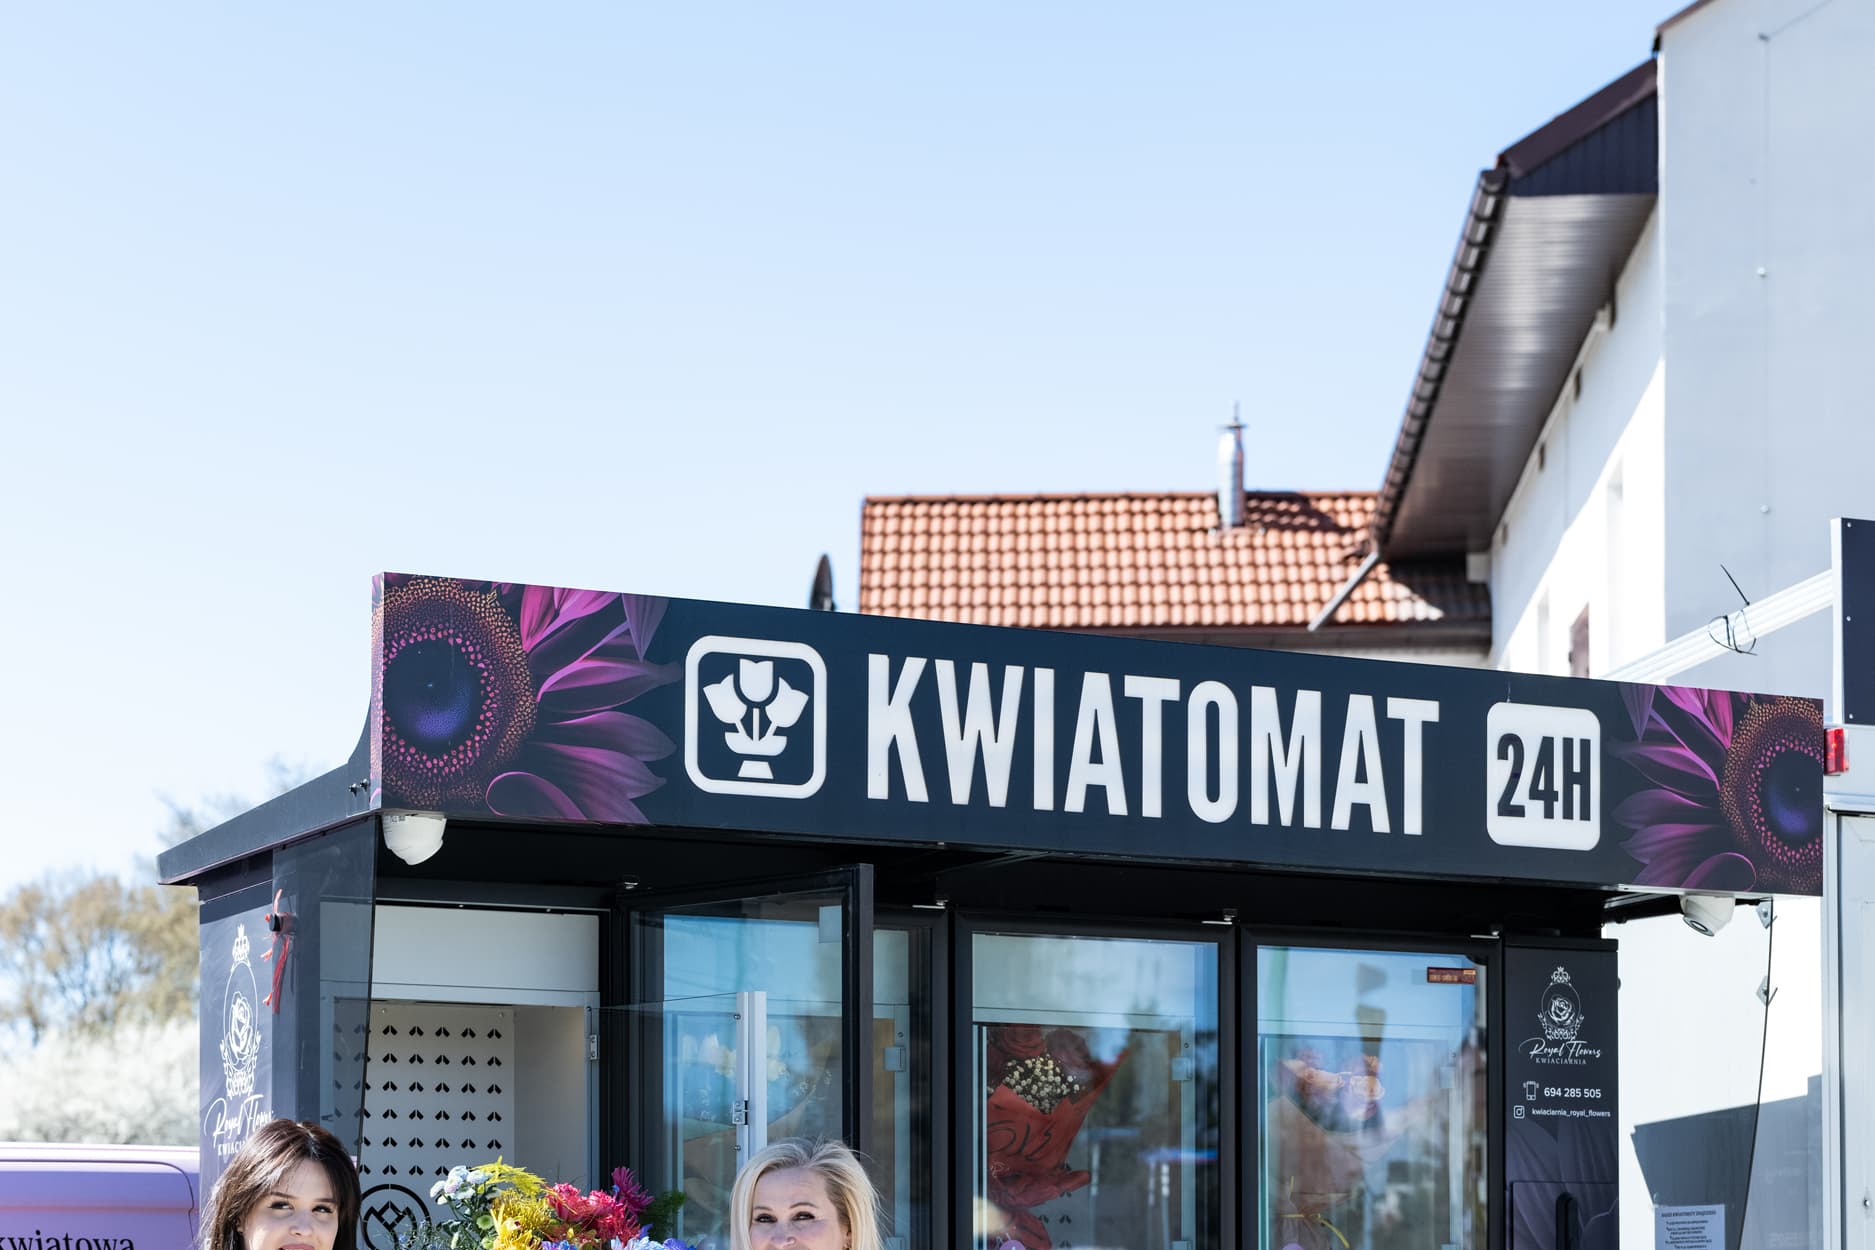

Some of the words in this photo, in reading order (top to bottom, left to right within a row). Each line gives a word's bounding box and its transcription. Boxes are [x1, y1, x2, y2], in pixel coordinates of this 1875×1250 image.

[867, 653, 1440, 836] KWIATOMAT
[1497, 732, 1592, 822] 24H
[1518, 1037, 1565, 1060] Royal
[1565, 1040, 1602, 1060] Flowers
[1535, 1057, 1588, 1065] KWIACIARNIA
[1543, 1087, 1562, 1097] 694
[1563, 1088, 1582, 1098] 285
[1583, 1088, 1602, 1099] 505
